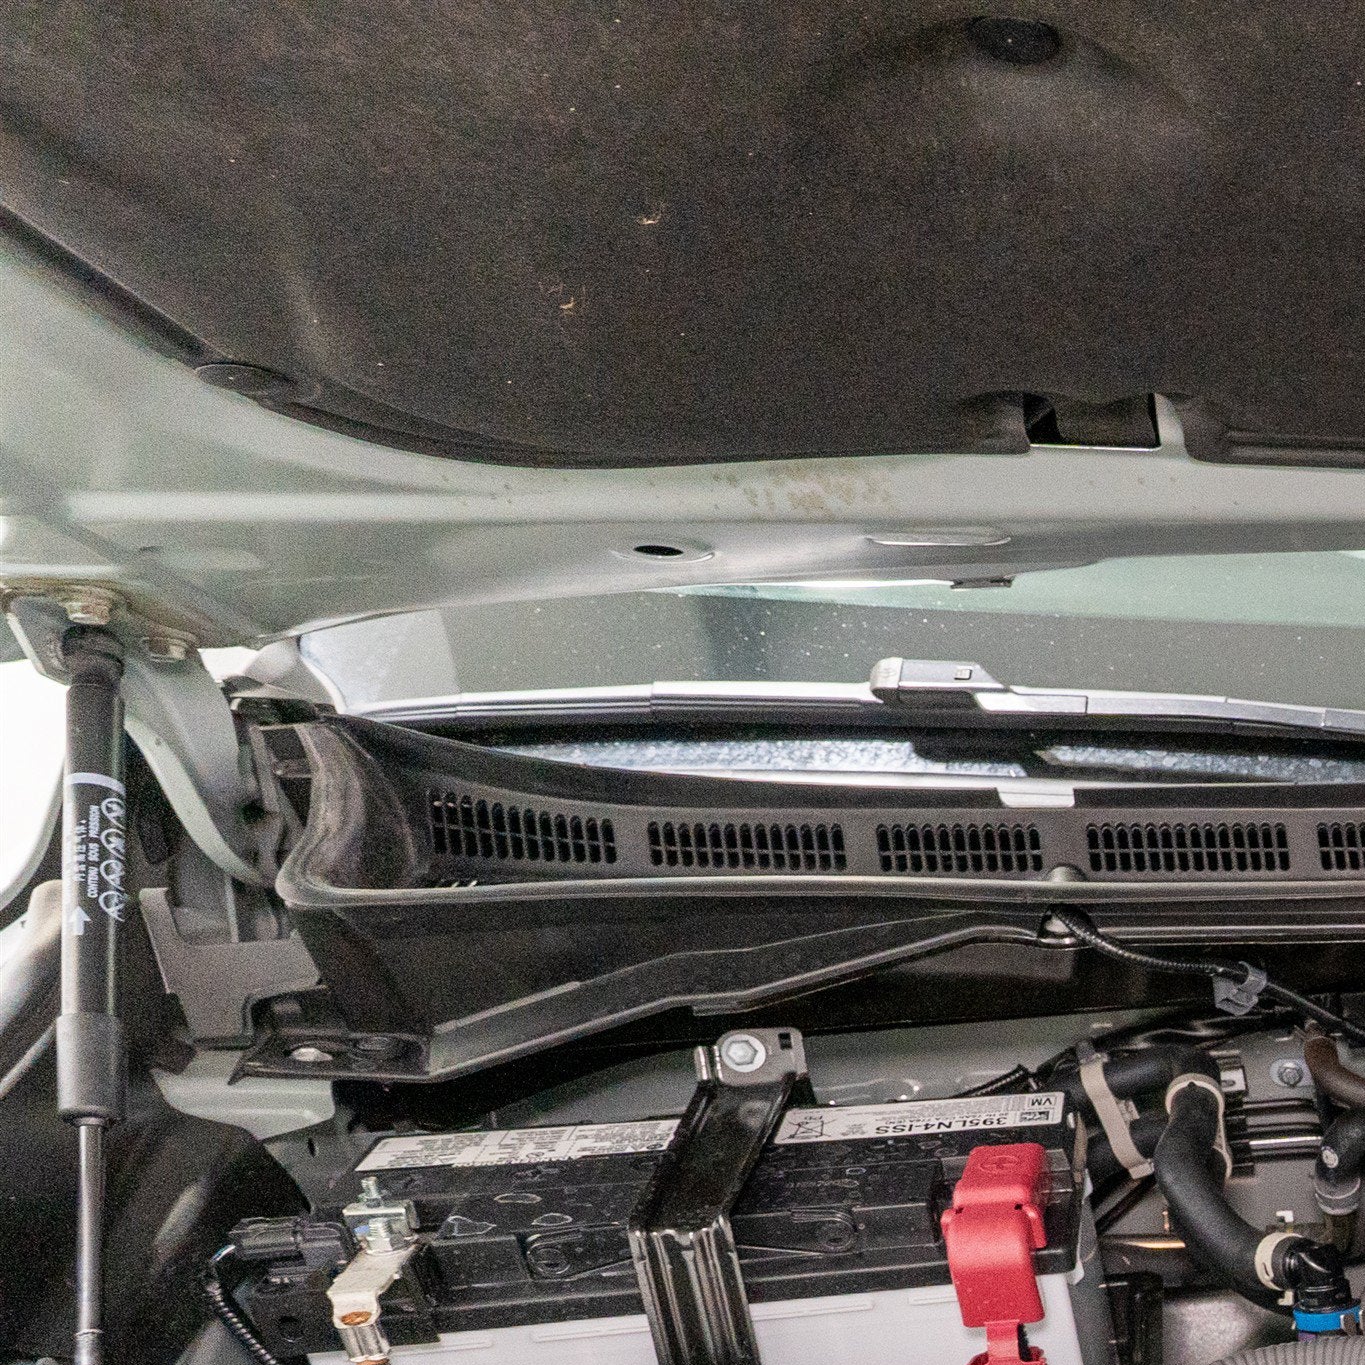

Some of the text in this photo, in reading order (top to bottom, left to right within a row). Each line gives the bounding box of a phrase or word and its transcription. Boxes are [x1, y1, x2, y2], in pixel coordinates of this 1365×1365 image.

[88, 843, 99, 862] SOUS
[1031, 1098, 1053, 1107] VM
[875, 1116, 1008, 1135] 395LN4-ISS
